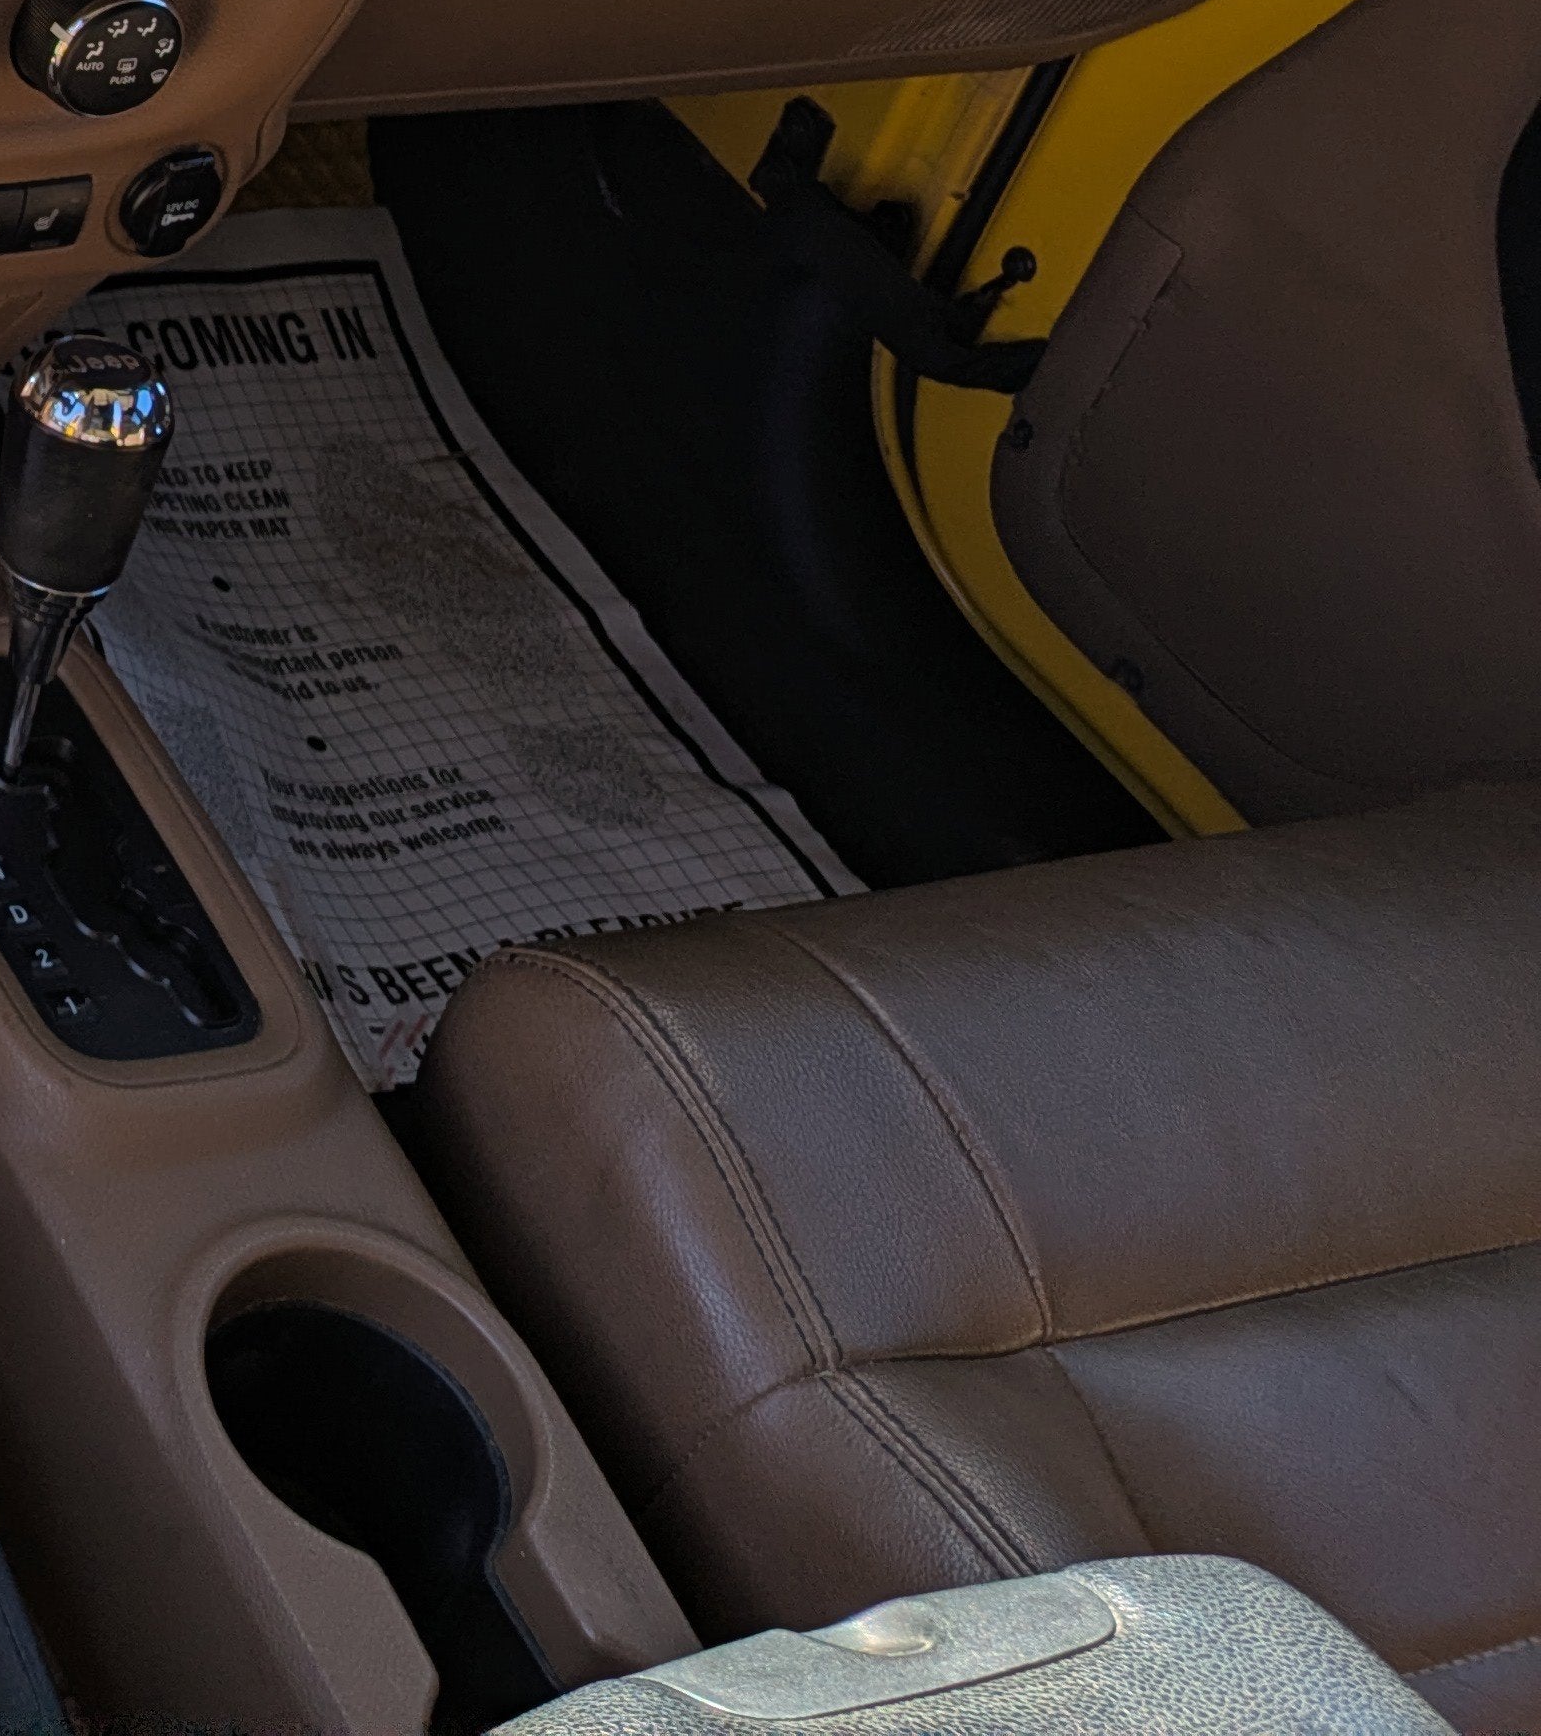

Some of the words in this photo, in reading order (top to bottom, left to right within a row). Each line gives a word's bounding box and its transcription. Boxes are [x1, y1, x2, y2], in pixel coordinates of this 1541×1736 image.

[75, 61, 105, 72] AUTO
[109, 74, 136, 85] PUSH
[125, 311, 319, 372] COMING
[320, 305, 378, 362] IN
[69, 352, 141, 374] Jeep
[224, 459, 275, 484] KEEP
[224, 485, 290, 514] CLEAN
[248, 516, 293, 539] MAT
[327, 644, 403, 670] person
[298, 772, 431, 807] suggestions
[410, 789, 497, 821] service
[401, 815, 516, 853] welcome.
[8, 904, 29, 925] D
[34, 948, 55, 970] 2
[366, 945, 483, 1006] BEEN
[62, 996, 79, 1015] 1
